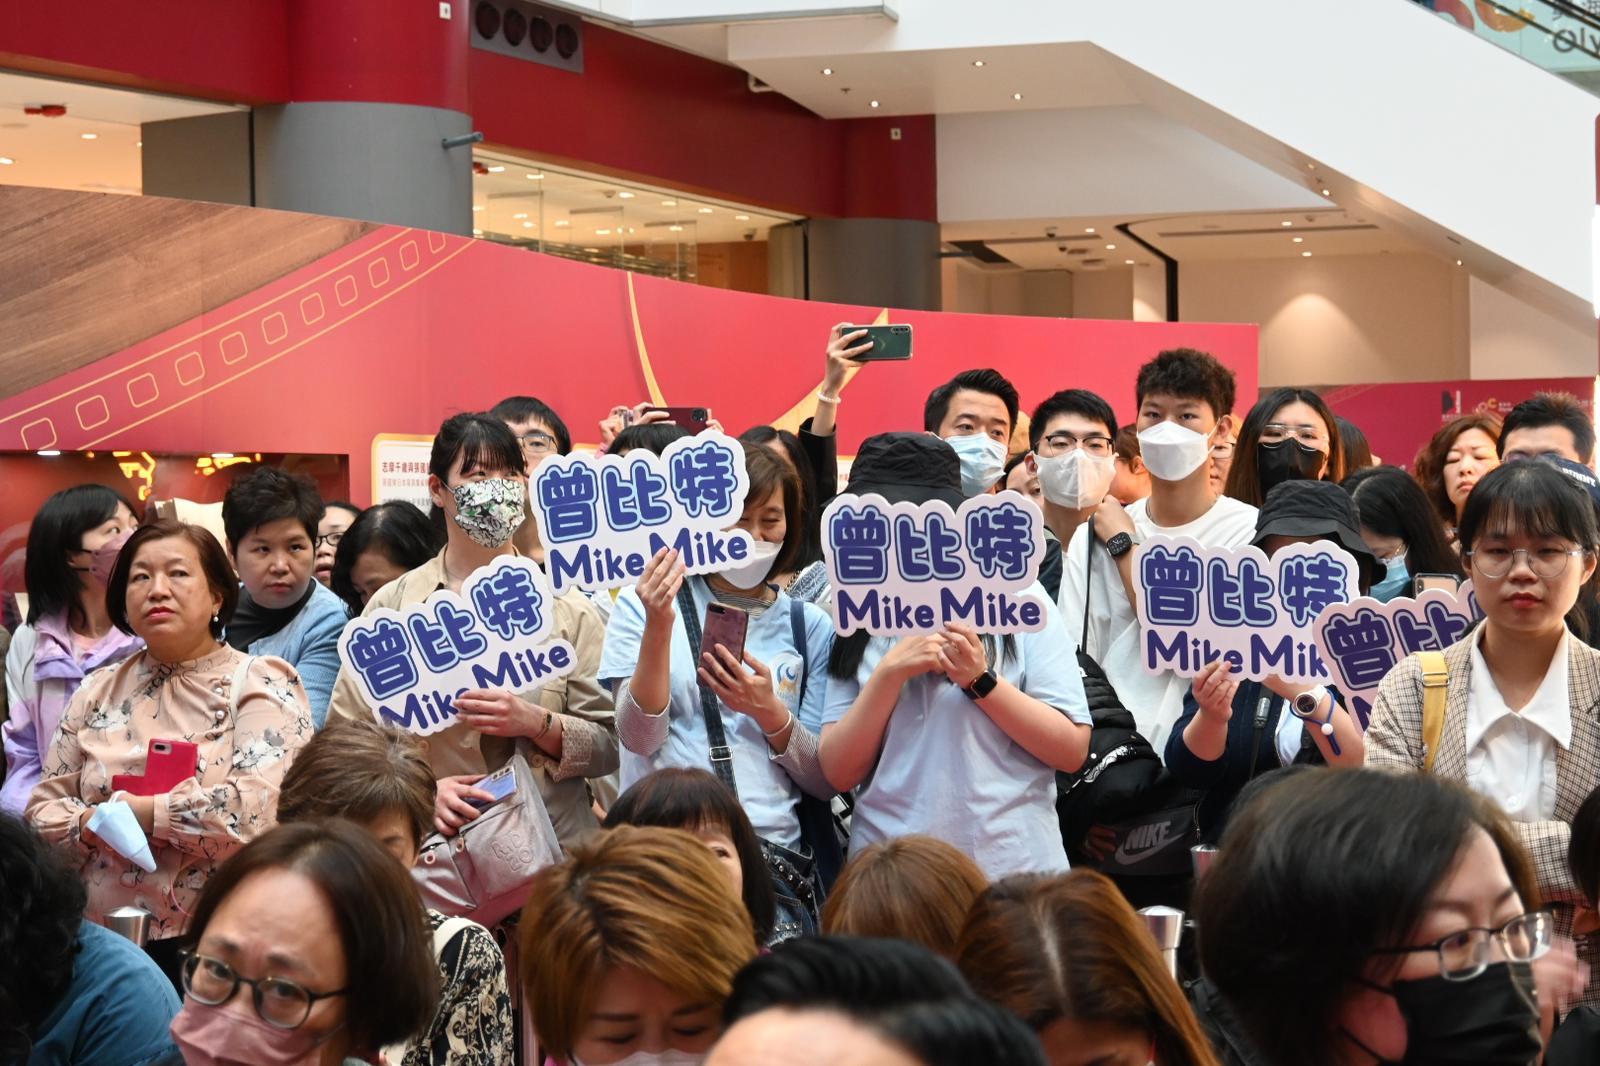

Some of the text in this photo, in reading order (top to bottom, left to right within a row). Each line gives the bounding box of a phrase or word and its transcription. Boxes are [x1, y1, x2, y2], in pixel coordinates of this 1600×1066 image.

[537, 441, 738, 543] 曾比特
[549, 528, 748, 589] Mike Mike
[829, 502, 1035, 585] 曾比特
[837, 586, 1040, 629] Mike Mike
[1141, 544, 1349, 628] 曾比特
[346, 565, 543, 701] 曾比特
[471, 645, 571, 689] Mike
[1147, 629, 1328, 677] Mike Mik
[1322, 590, 1487, 691] 曾比
[1124, 821, 1171, 850] NIKE
